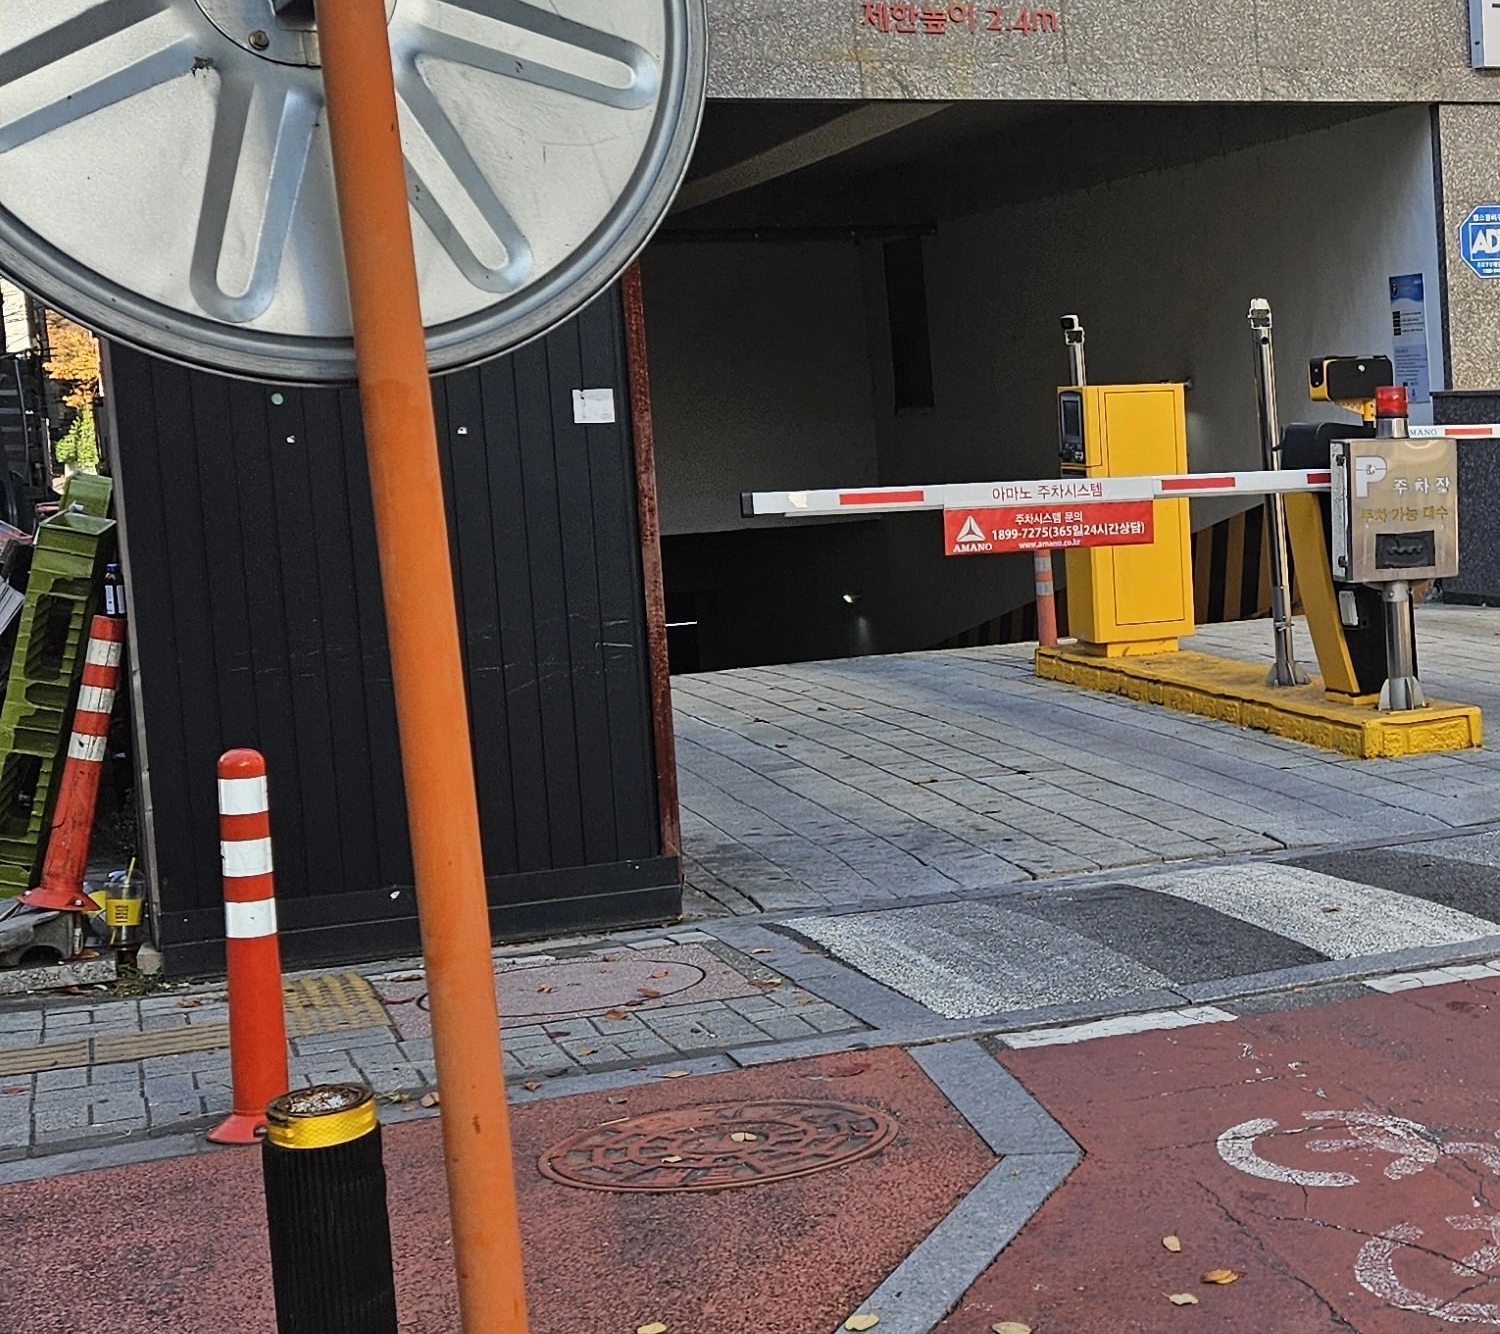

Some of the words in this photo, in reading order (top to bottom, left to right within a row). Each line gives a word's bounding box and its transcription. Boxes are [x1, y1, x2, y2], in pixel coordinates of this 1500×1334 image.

[861, 1, 977, 34] 제한높이
[985, 6, 1058, 34] 2.4m
[1409, 428, 1438, 437] MANO
[1355, 455, 1388, 498] P
[992, 485, 1033, 501] 아마노
[1037, 482, 1103, 499] 주차시스템
[1393, 476, 1451, 496] 주차장
[1015, 512, 1062, 525] 주차시스템
[1064, 511, 1084, 523] 문의
[1360, 507, 1388, 523] 주차
[1391, 506, 1419, 522] 가능
[1422, 505, 1449, 520] 대수
[991, 521, 1146, 541] 1899-7275(365일24시간상담)
[953, 542, 993, 553] AMANO
[1018, 538, 1082, 550] www.amano.co.kr
